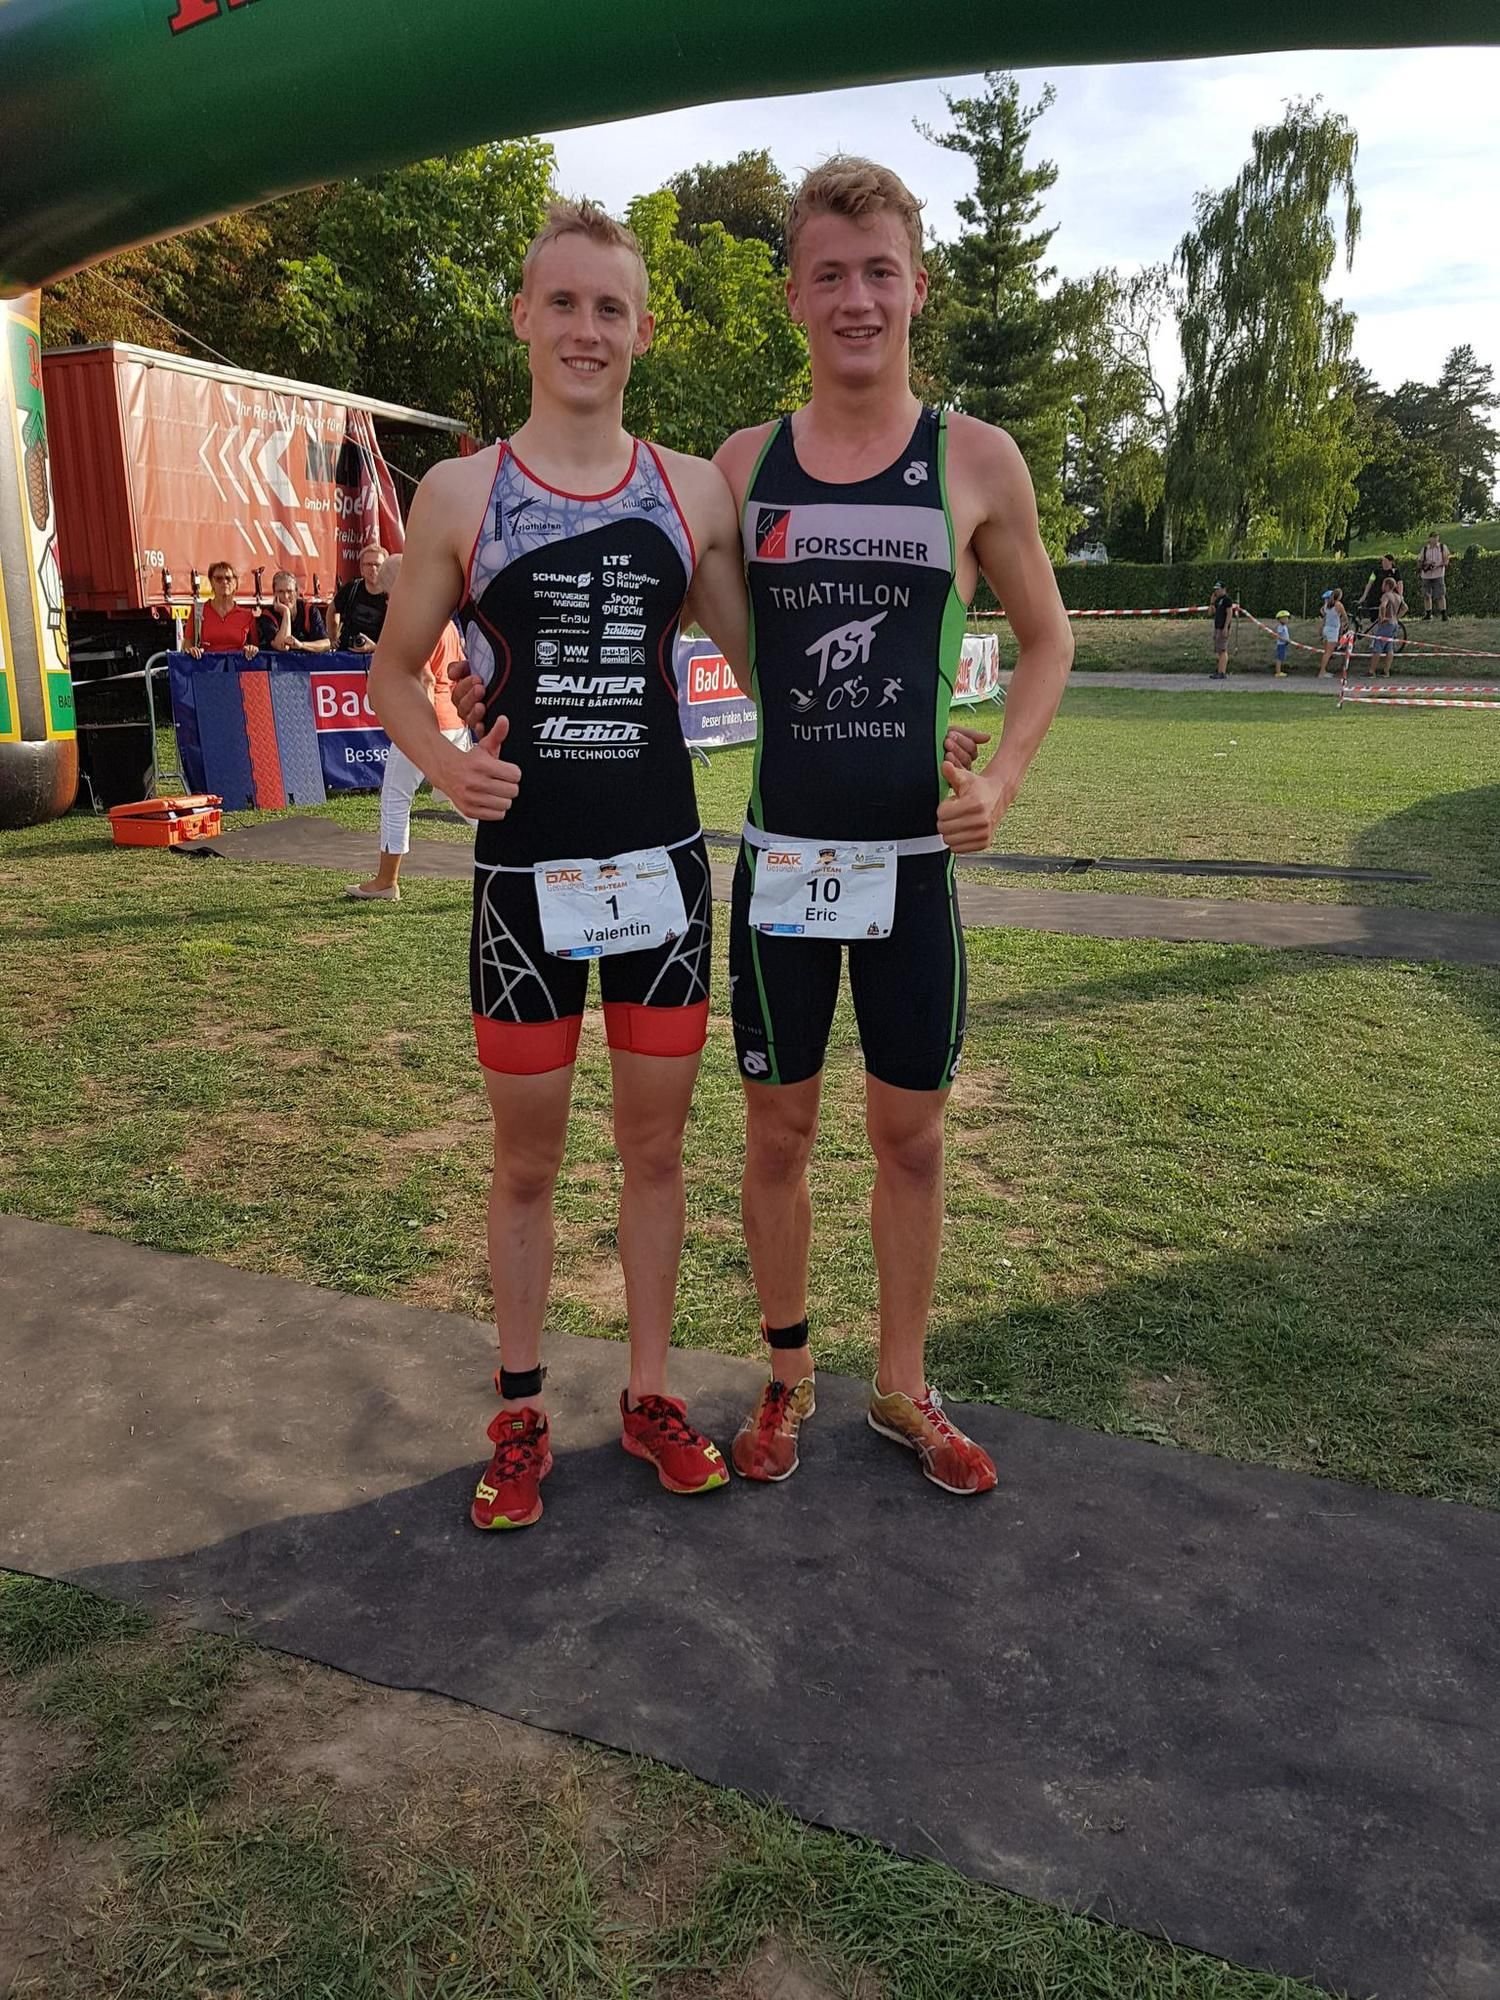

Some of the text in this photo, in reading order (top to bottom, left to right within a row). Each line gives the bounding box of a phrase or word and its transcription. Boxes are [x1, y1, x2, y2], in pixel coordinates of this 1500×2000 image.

[304, 497, 330, 511] GmbH
[794, 536, 929, 562] FORSCHNER
[144, 550, 164, 567] 769
[602, 555, 630, 566] LTS
[532, 572, 577, 584] SCHUNK
[617, 571, 660, 585] Schwörer
[617, 580, 641, 589] Haus
[534, 590, 590, 601] STADTWERKE
[605, 592, 643, 605] SPORT
[769, 582, 911, 610] TRIATHLON
[553, 599, 590, 608] MENGEN
[602, 605, 644, 616] DIETSCHE
[560, 613, 590, 624] EnBW
[536, 674, 646, 694] SAUTER
[695, 662, 720, 692] Bad
[535, 695, 643, 708] DREHTEILE BÄRENTHAL
[540, 716, 641, 741] Hettich
[702, 715, 721, 728] Besser
[791, 721, 906, 742] TUTTLINGEN
[539, 748, 640, 760] LAB TECHNOLOGY
[767, 852, 802, 865] DAK
[545, 868, 584, 884] DAK
[806, 878, 841, 903] 10
[605, 895, 620, 921] 1
[805, 907, 838, 922] Eric
[583, 922, 651, 942] Valentin
